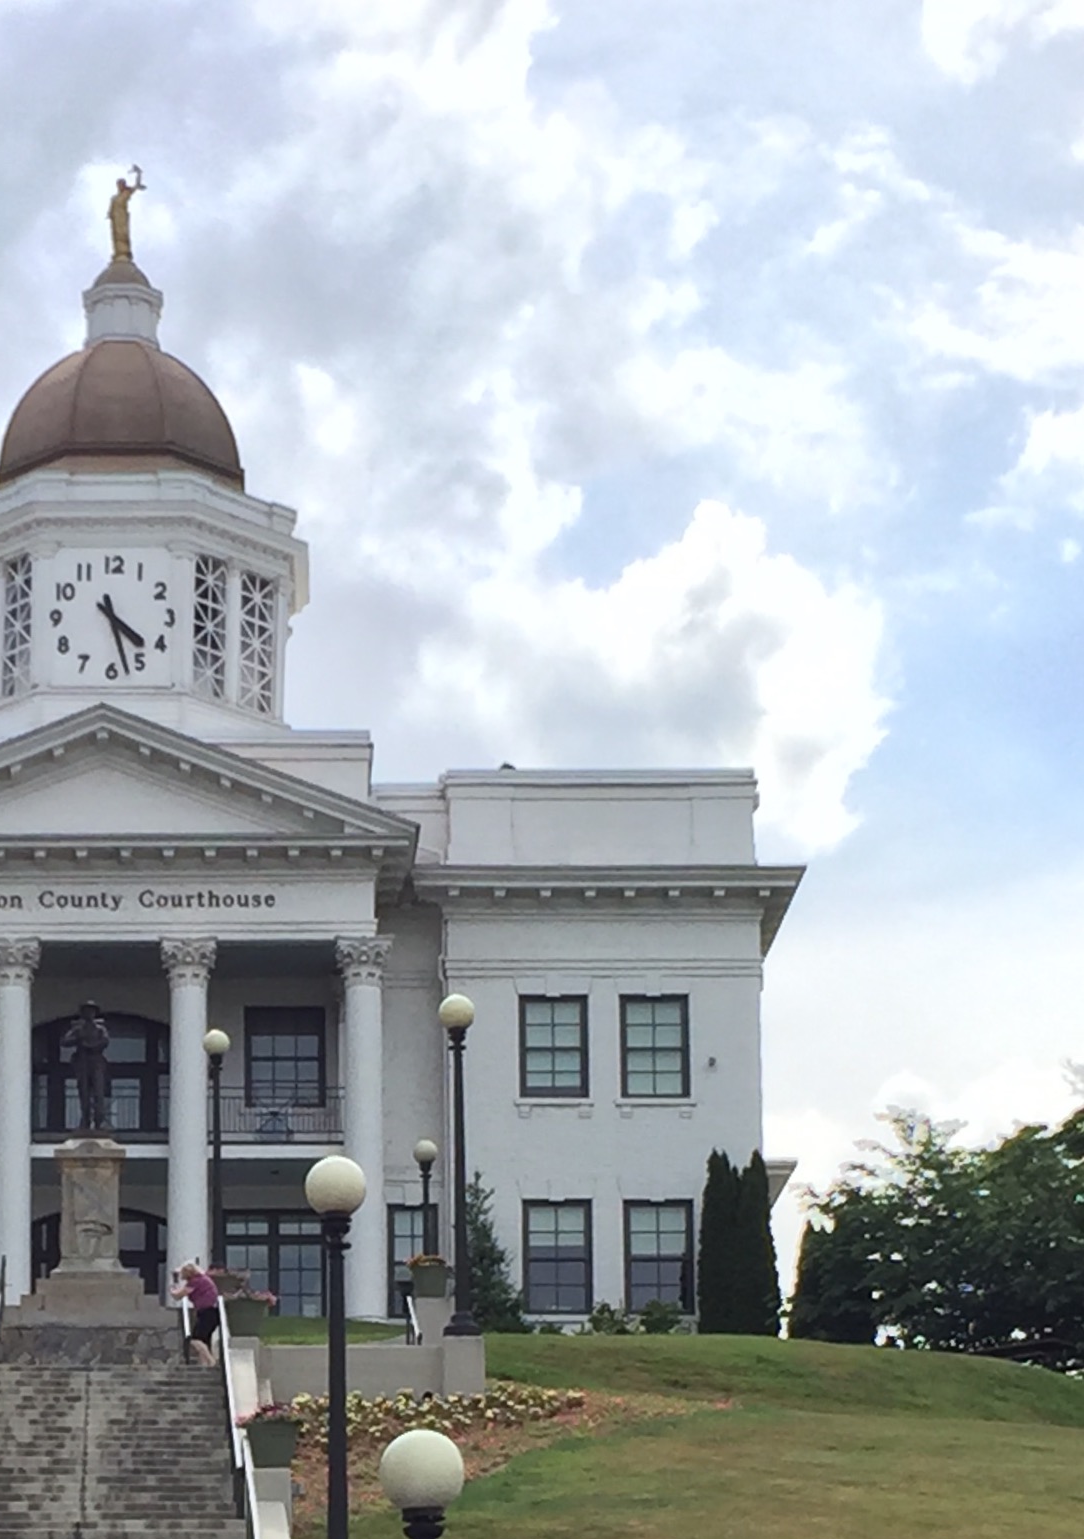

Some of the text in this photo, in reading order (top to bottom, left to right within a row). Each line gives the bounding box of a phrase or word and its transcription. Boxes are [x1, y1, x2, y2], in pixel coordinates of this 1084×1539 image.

[77, 563, 92, 582] 11
[104, 555, 125, 575] 12
[137, 562, 143, 582] 1
[56, 582, 76, 601] 10
[153, 582, 167, 601] 2
[49, 609, 63, 628] 9
[164, 608, 176, 628] 3
[57, 636, 70, 655] 8
[154, 634, 168, 653] 4
[77, 654, 91, 674] 7
[105, 662, 119, 680] 6
[134, 652, 146, 671] 5
[37, 890, 123, 911] County
[138, 889, 277, 908] Courthouse
